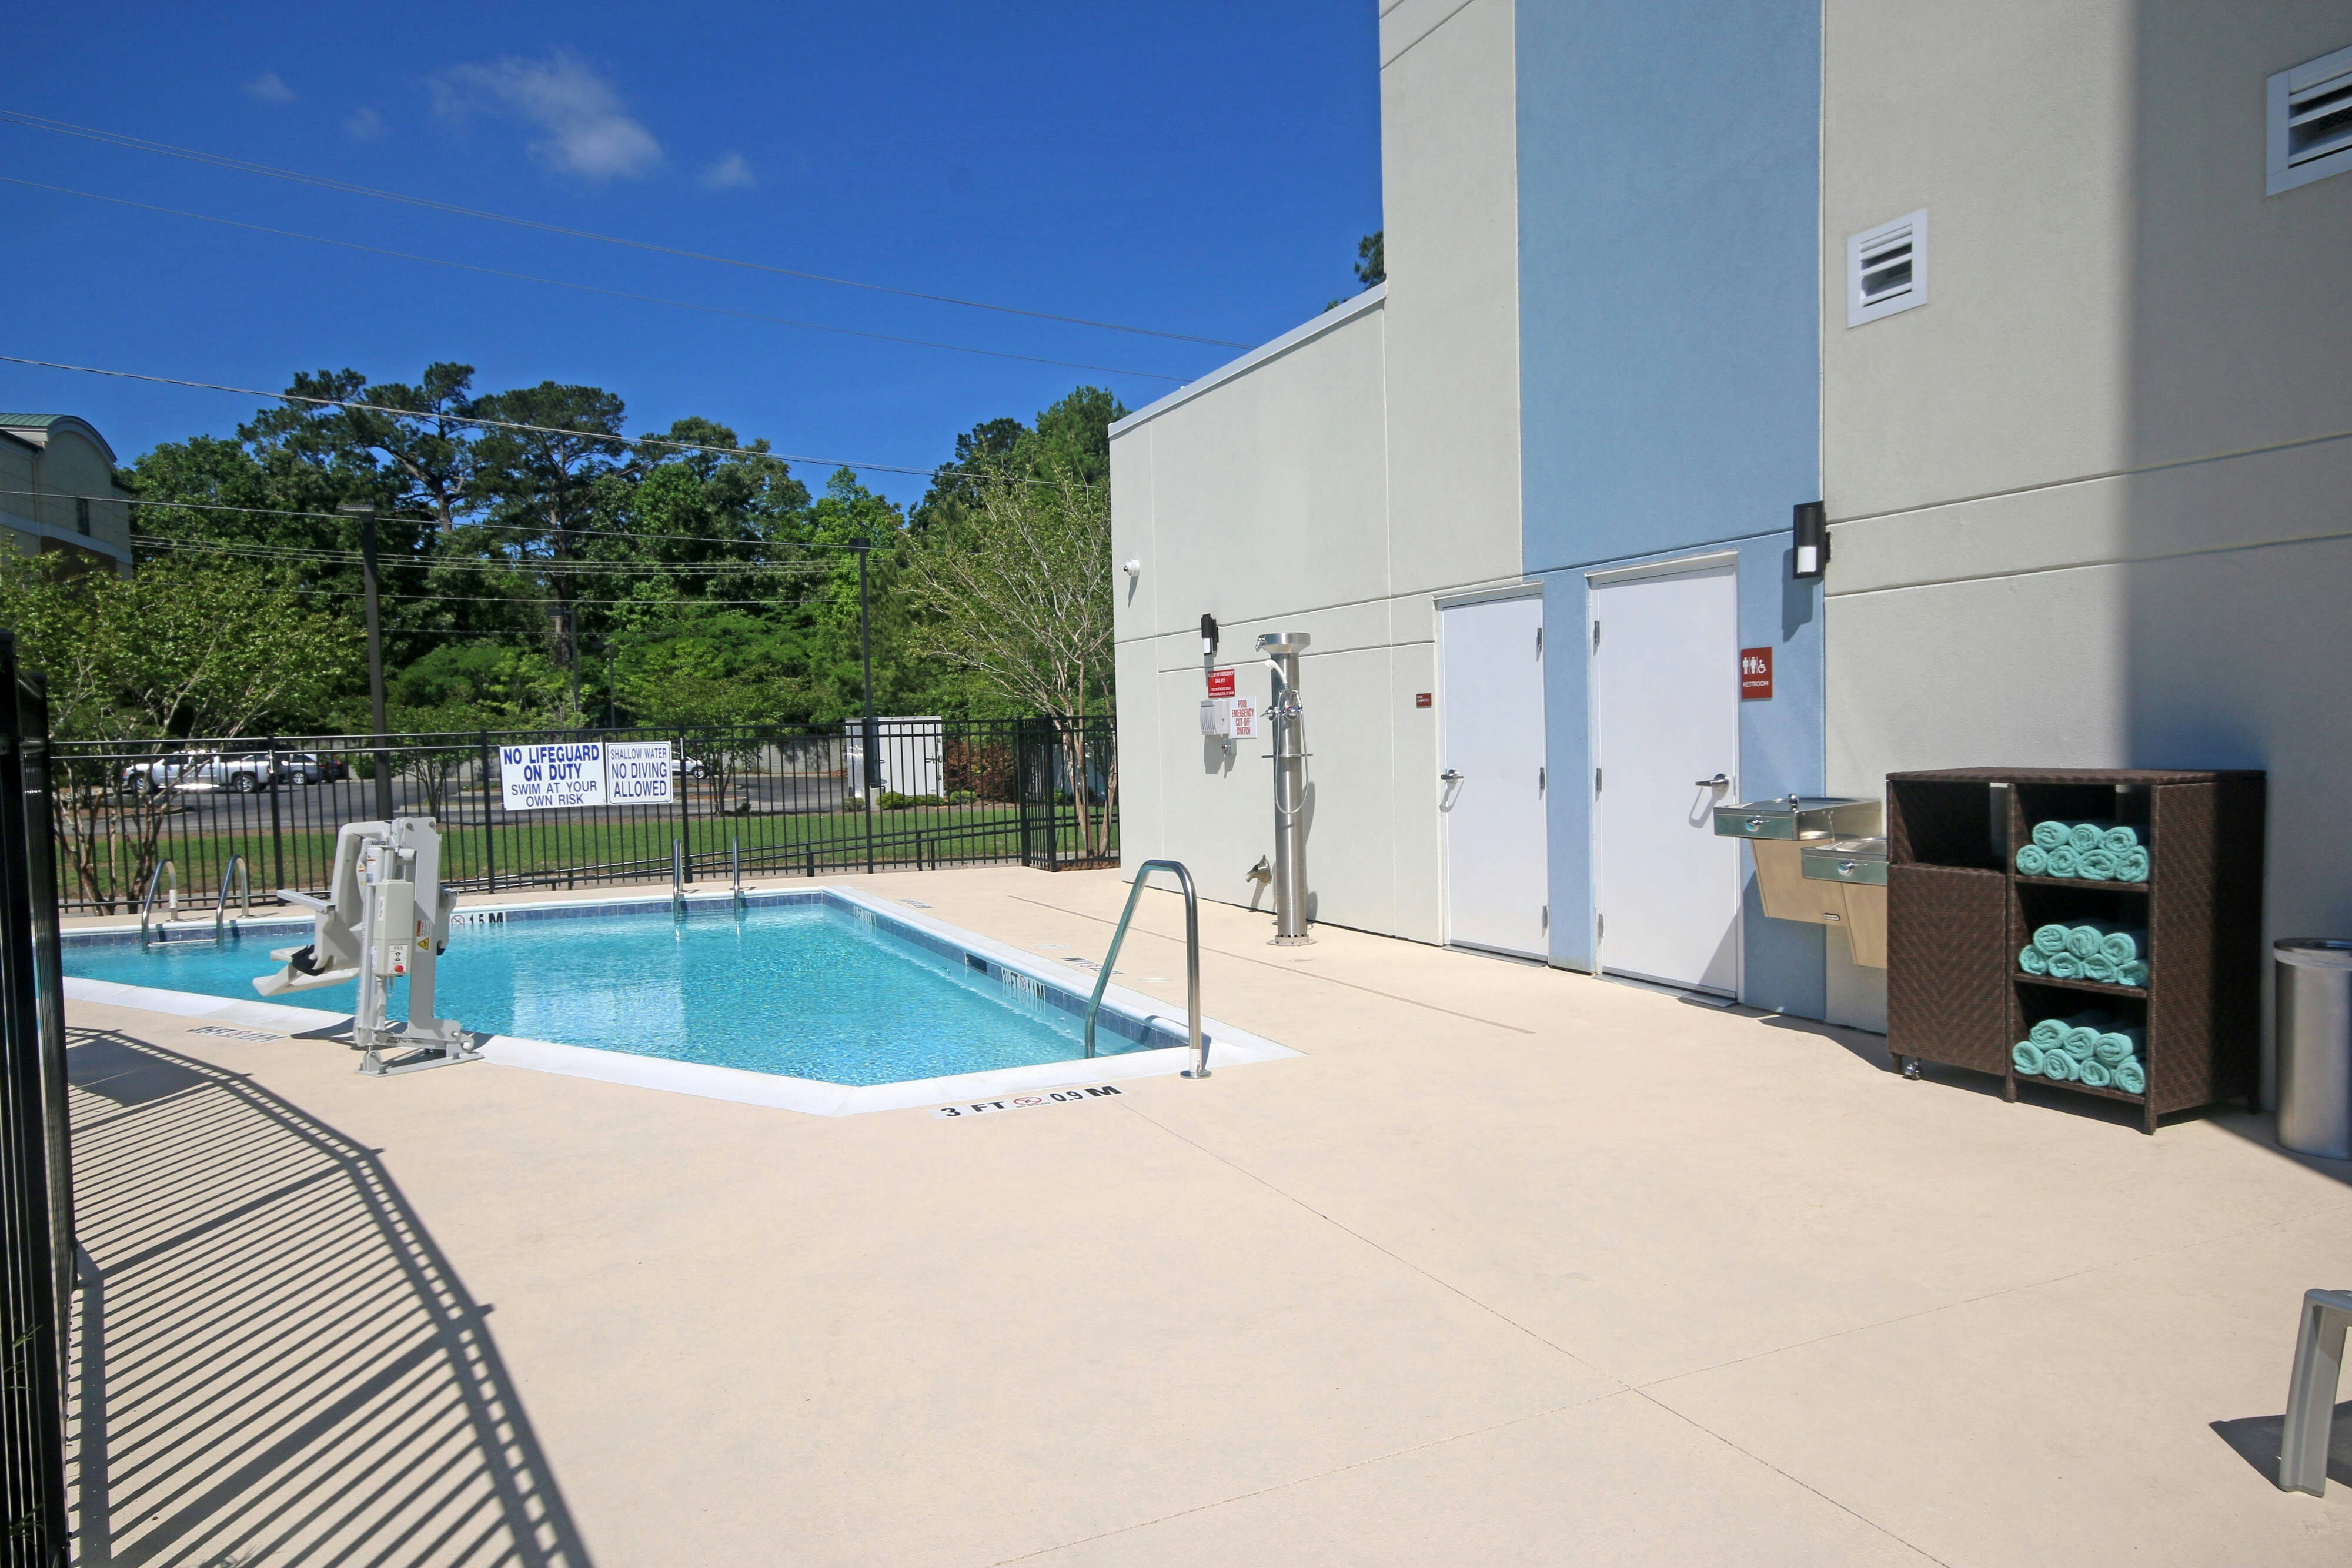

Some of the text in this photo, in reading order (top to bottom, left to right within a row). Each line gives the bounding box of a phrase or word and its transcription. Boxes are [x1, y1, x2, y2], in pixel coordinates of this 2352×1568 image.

[1238, 700, 1247, 708] POOL
[1232, 708, 1254, 717] EMERGENCY
[1235, 718, 1251, 726] CUT-OFF
[1236, 727, 1251, 735] SWITCH
[503, 745, 599, 765] NO LIFEGUARD
[611, 748, 667, 760] SHALLOW WATER
[524, 763, 582, 781] ON DUTY
[612, 761, 667, 779] NO DIVING
[511, 780, 597, 795] SWIM AT YOUR
[614, 780, 667, 797] ALLOWED
[526, 794, 584, 807] OWN RISK
[489, 912, 503, 923] M
[1036, 983, 1044, 1001] M
[941, 1107, 961, 1117] 3
[971, 1101, 1004, 1112] FT
[1084, 1086, 1122, 1097] M
